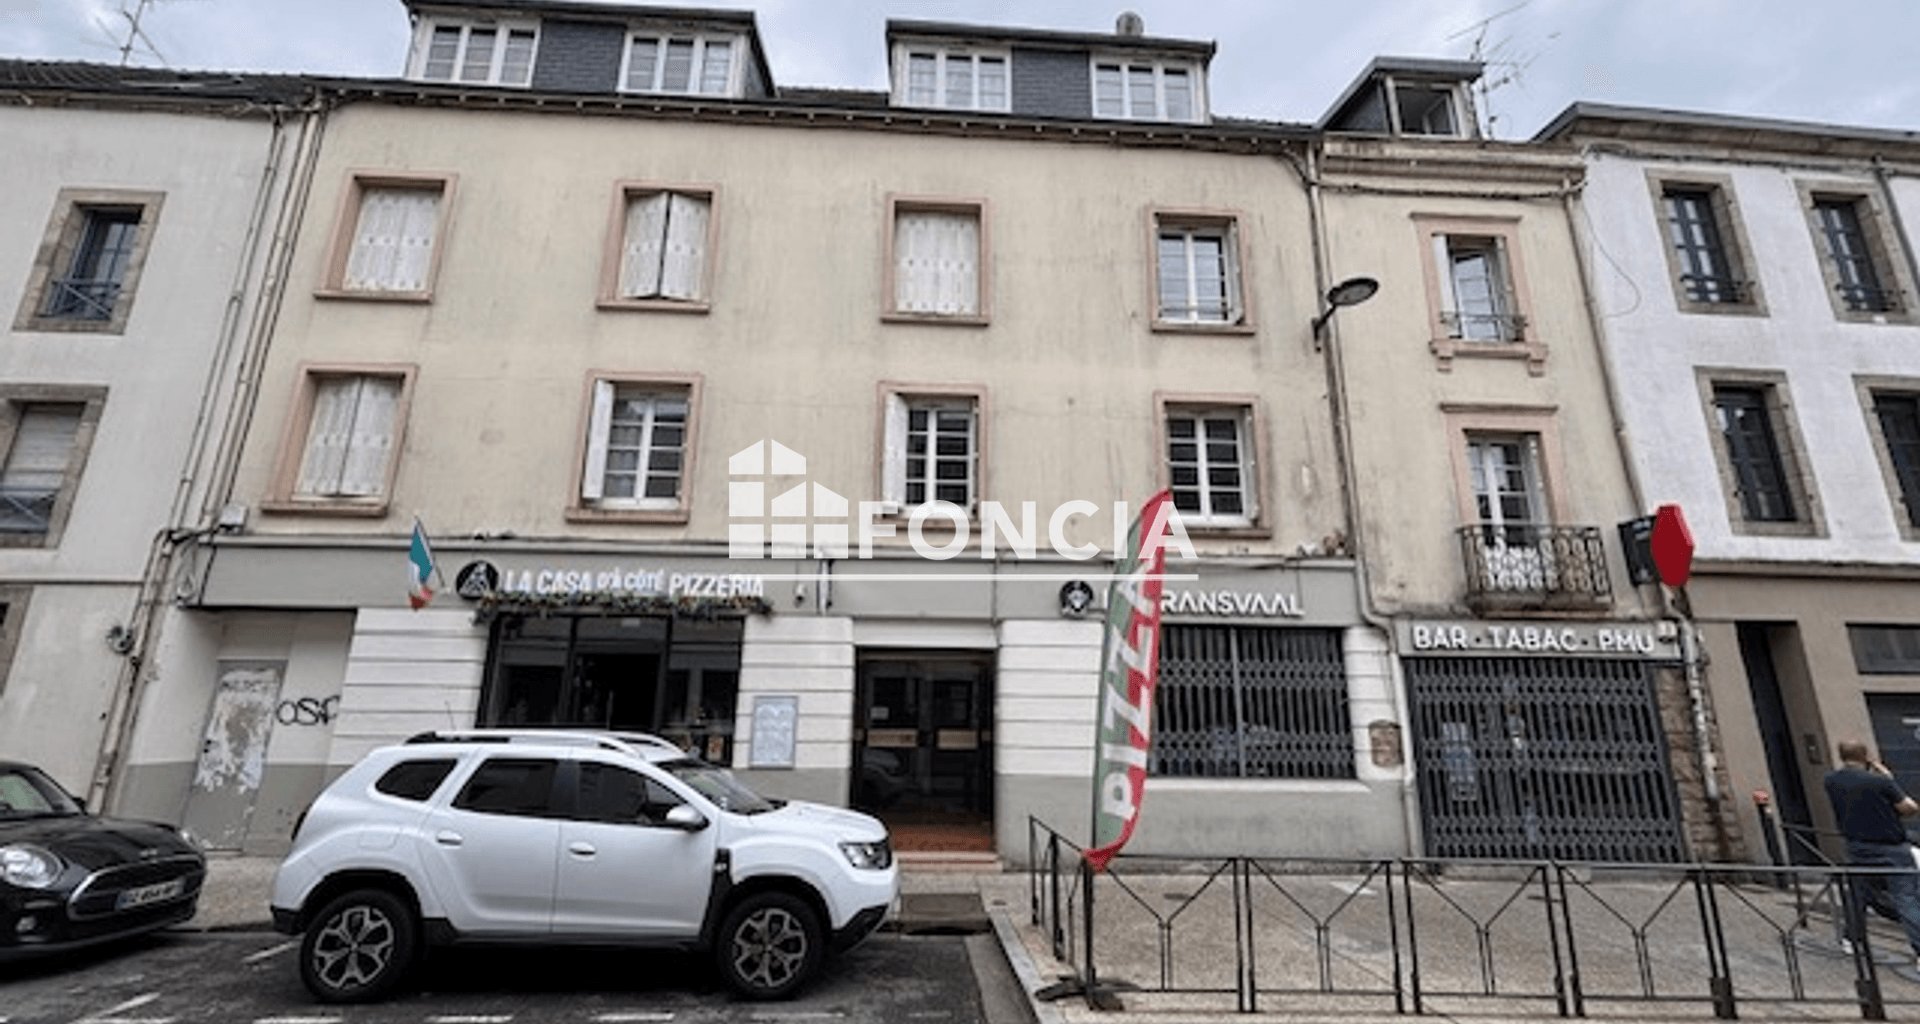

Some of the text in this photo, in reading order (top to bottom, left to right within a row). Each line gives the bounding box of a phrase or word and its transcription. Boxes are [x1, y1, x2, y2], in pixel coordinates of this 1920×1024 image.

[504, 569, 531, 592] LA
[537, 570, 591, 594] CASA
[669, 572, 765, 598] PIZZERIA
[1161, 588, 1303, 616] RANSVAAL
[1413, 625, 1655, 653] BAR TABAC PMU
[1103, 558, 1157, 821] PIZZA
